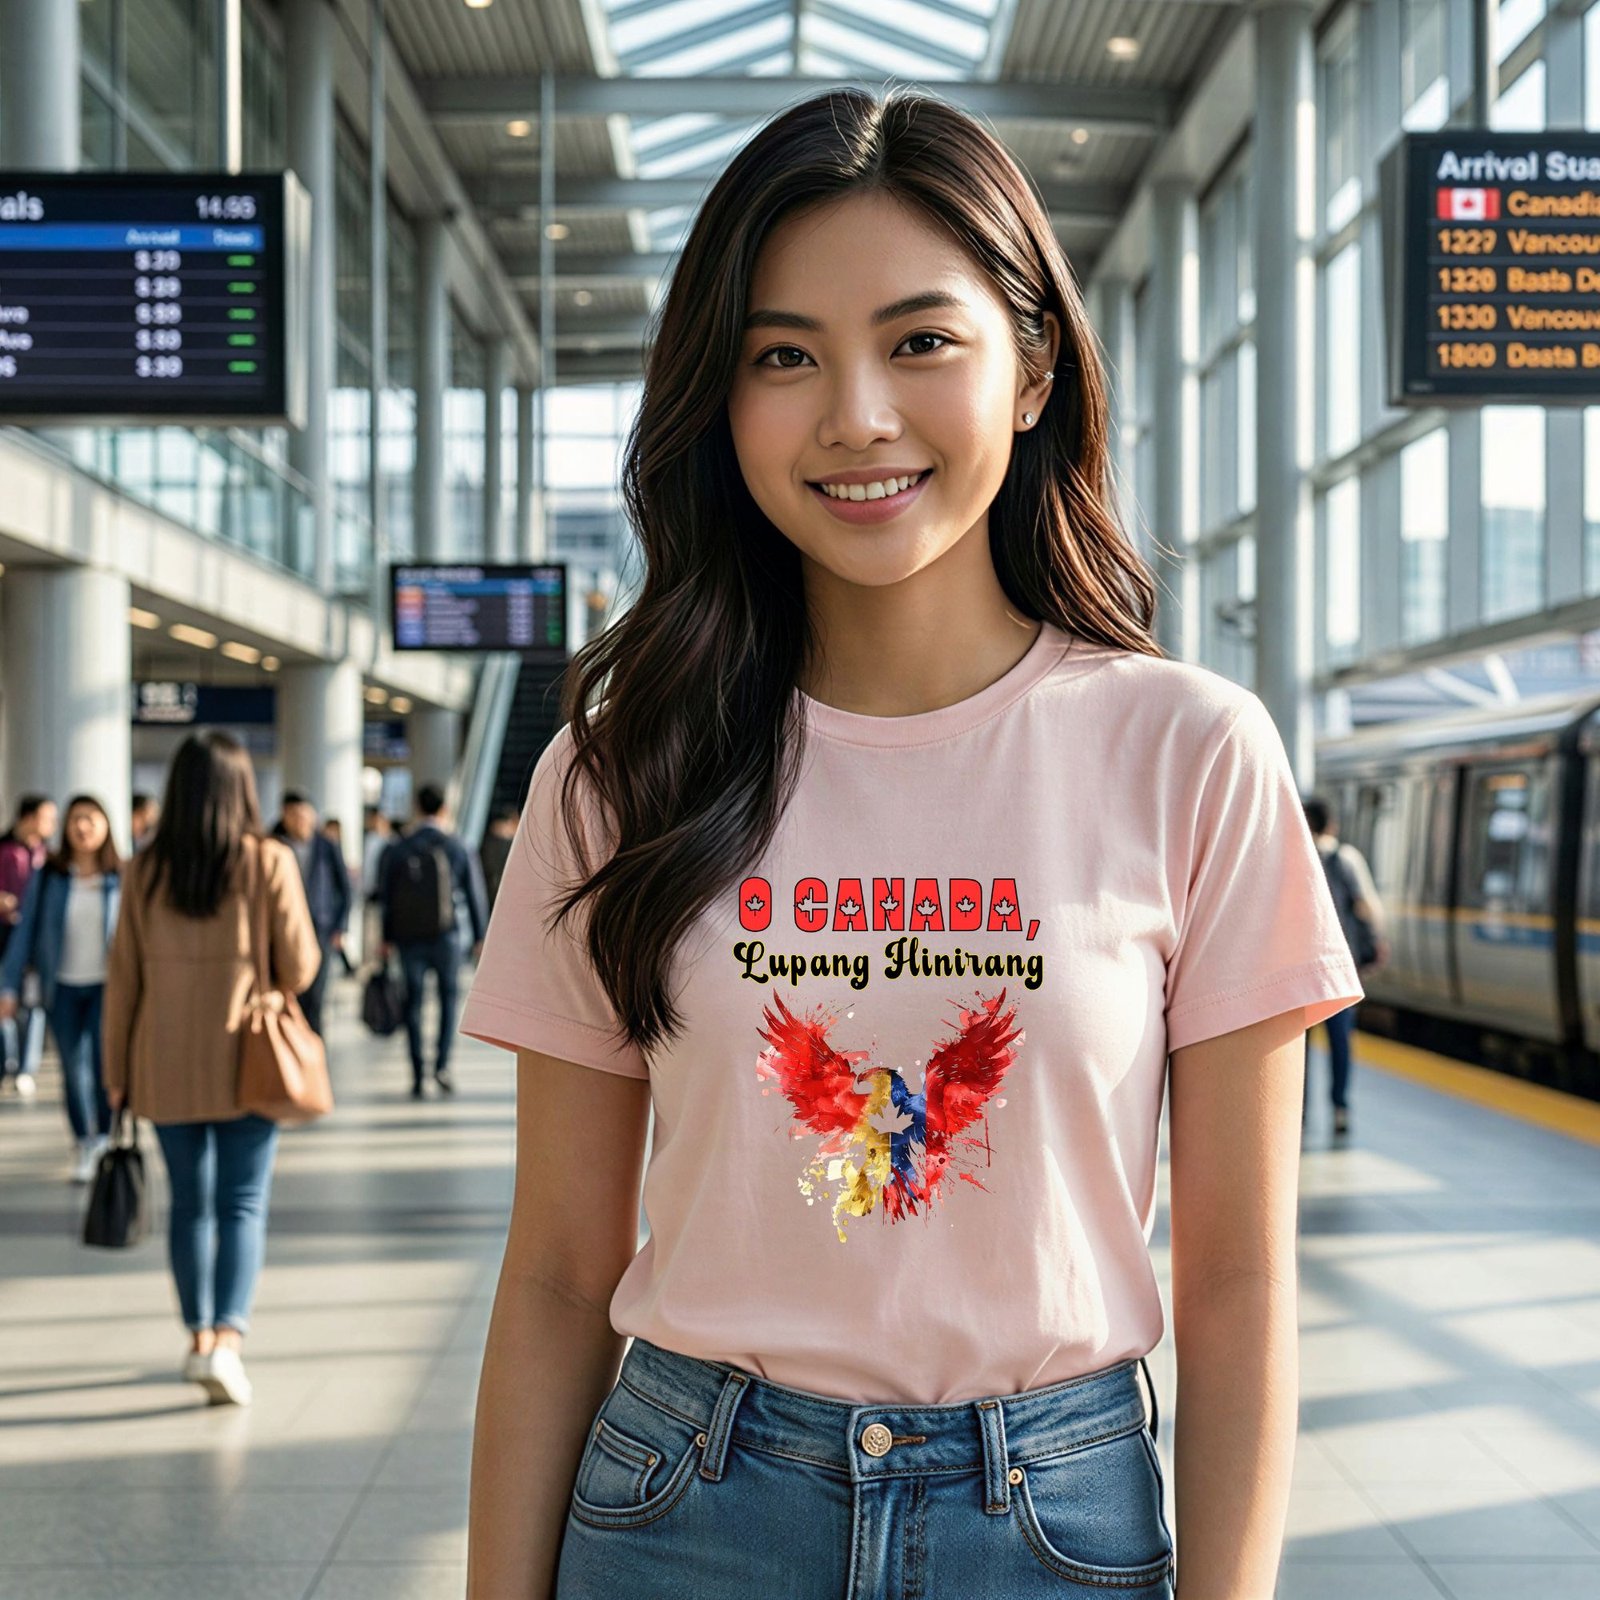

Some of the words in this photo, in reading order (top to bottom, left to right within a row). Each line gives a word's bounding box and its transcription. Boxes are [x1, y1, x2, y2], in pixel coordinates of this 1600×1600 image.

[0, 190, 44, 221] als
[738, 876, 772, 932] O
[794, 876, 1041, 941] CANADA,
[733, 941, 869, 990] Lupang
[884, 936, 1043, 990] Hinirang
